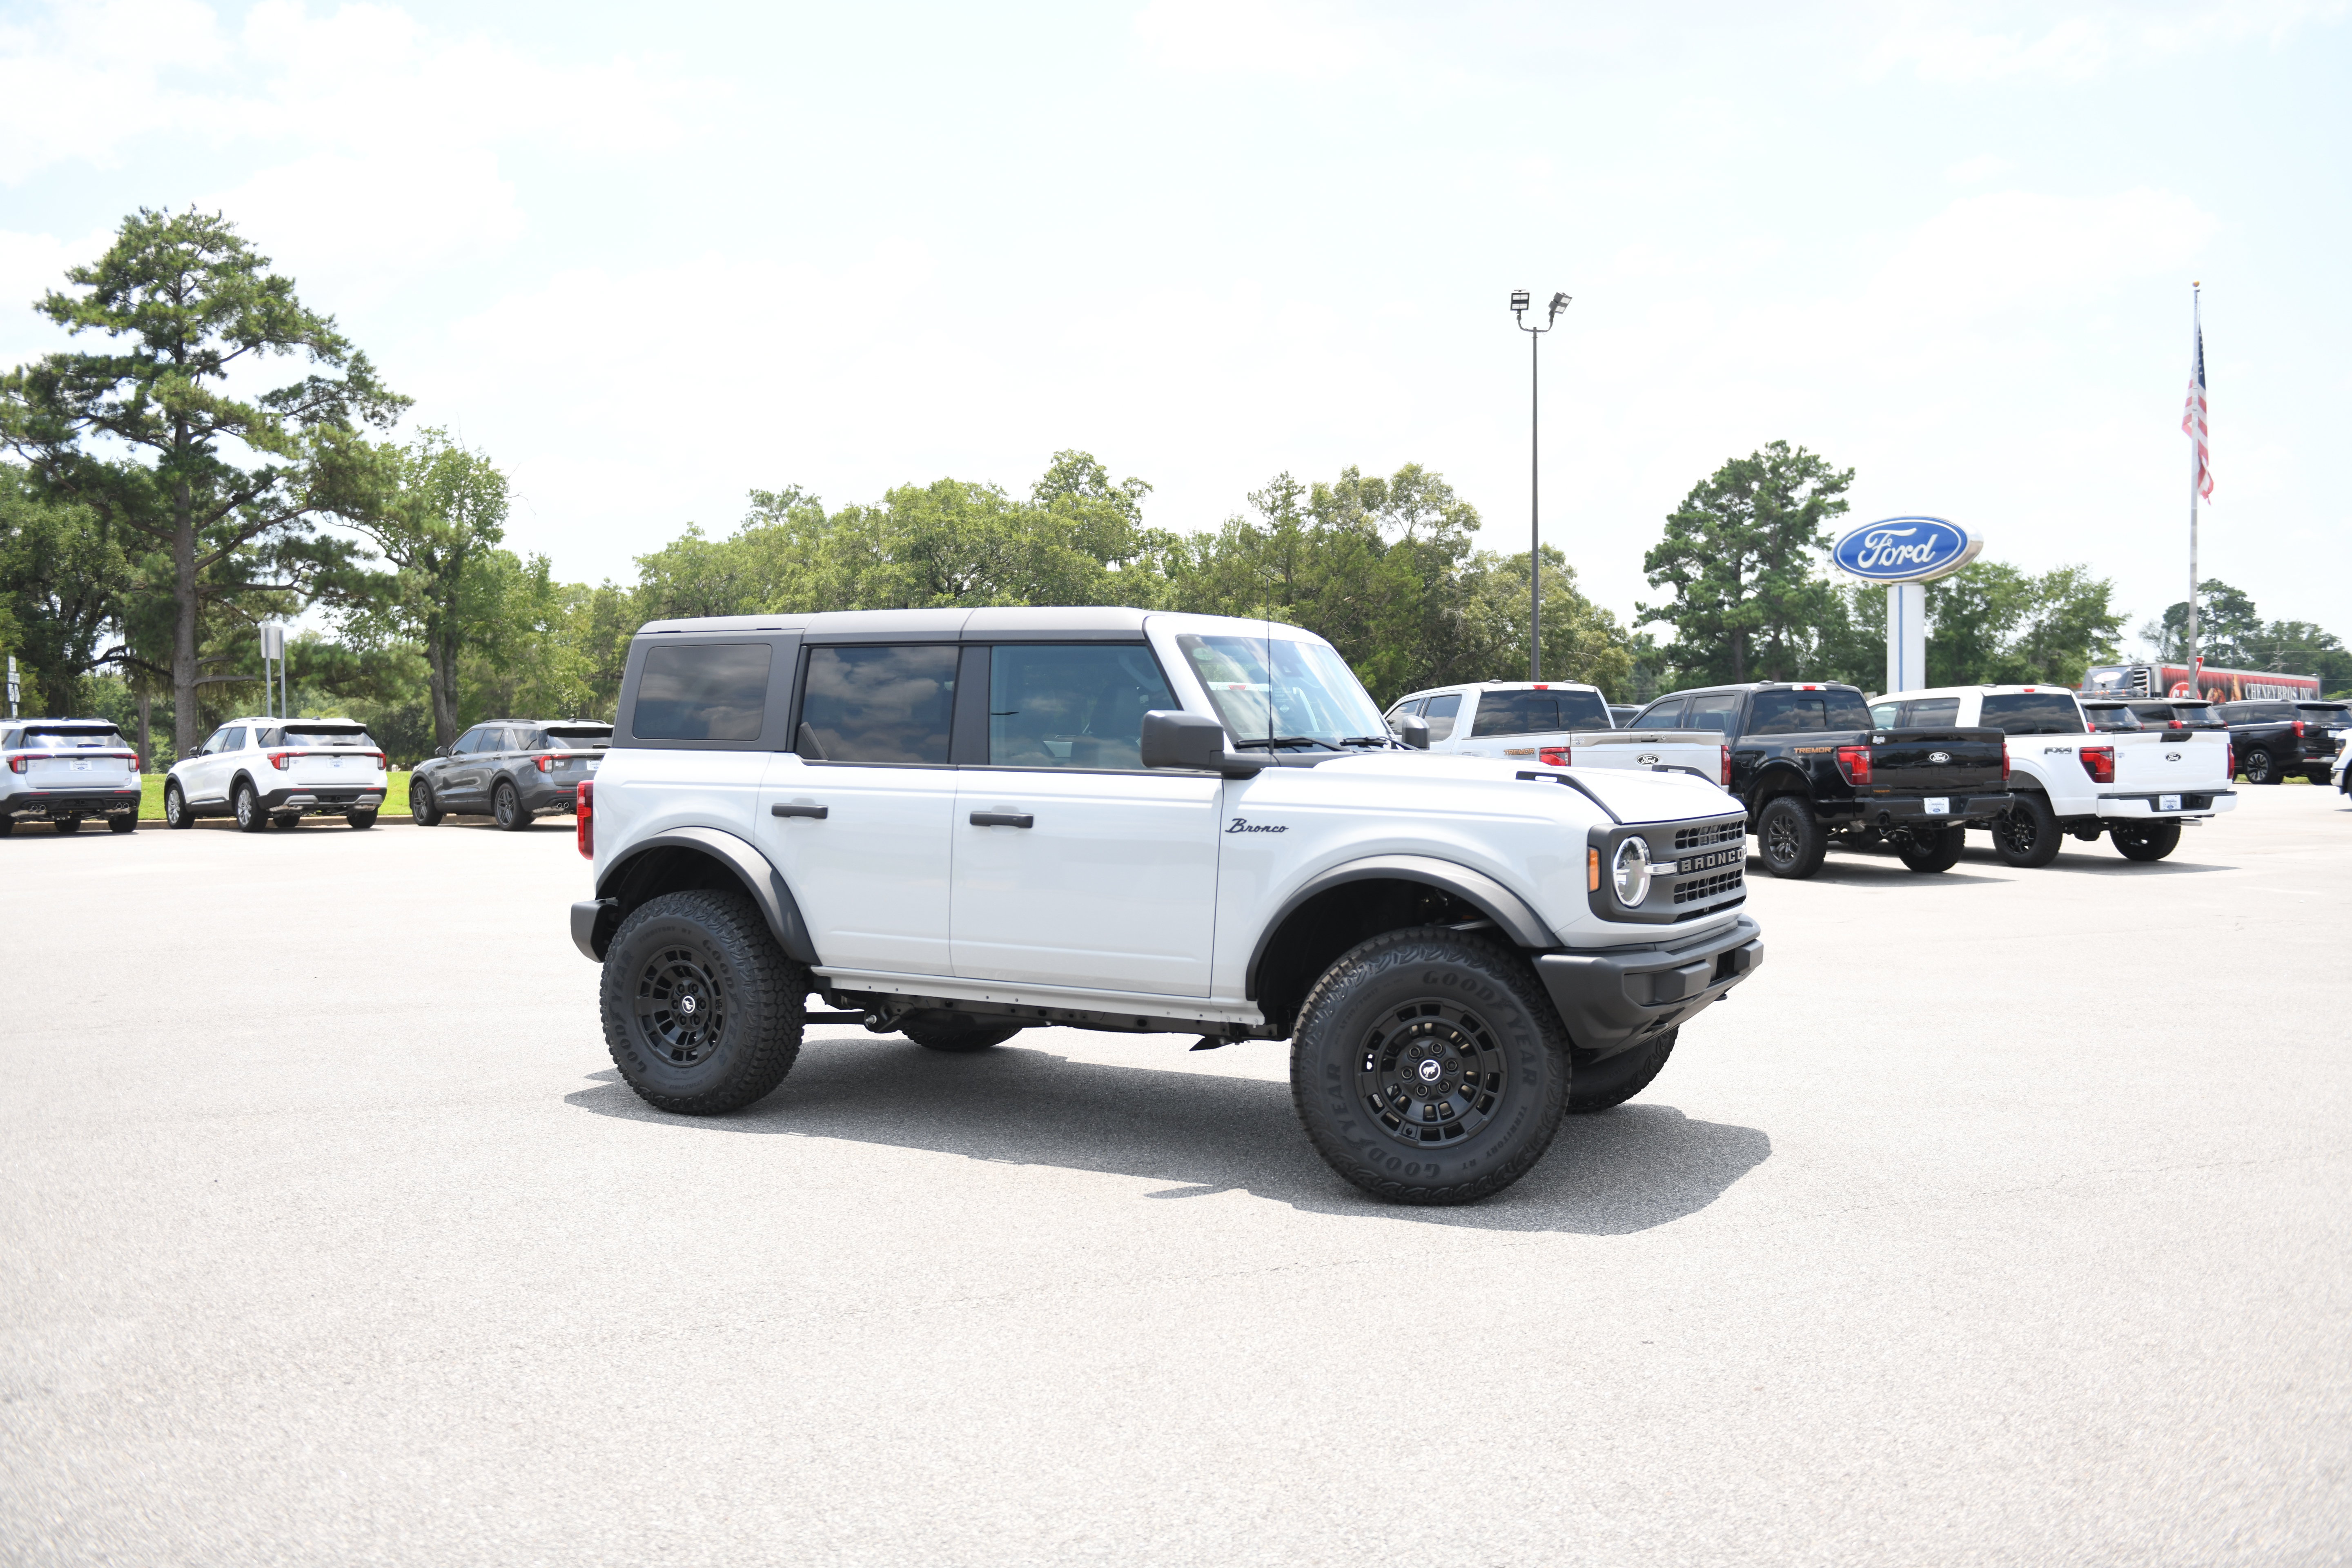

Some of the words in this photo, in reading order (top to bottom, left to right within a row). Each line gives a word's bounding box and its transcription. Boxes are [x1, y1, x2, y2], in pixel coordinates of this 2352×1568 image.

[1858, 527, 1938, 569] Ford
[2245, 683, 2276, 699] CHENEY
[2044, 746, 2072, 755] FX4
[1641, 755, 1656, 764] Ford
[1225, 818, 1290, 833] Bronco
[1682, 848, 1744, 872] BRONCO
[1486, 1105, 1528, 1160] TERRITORY
